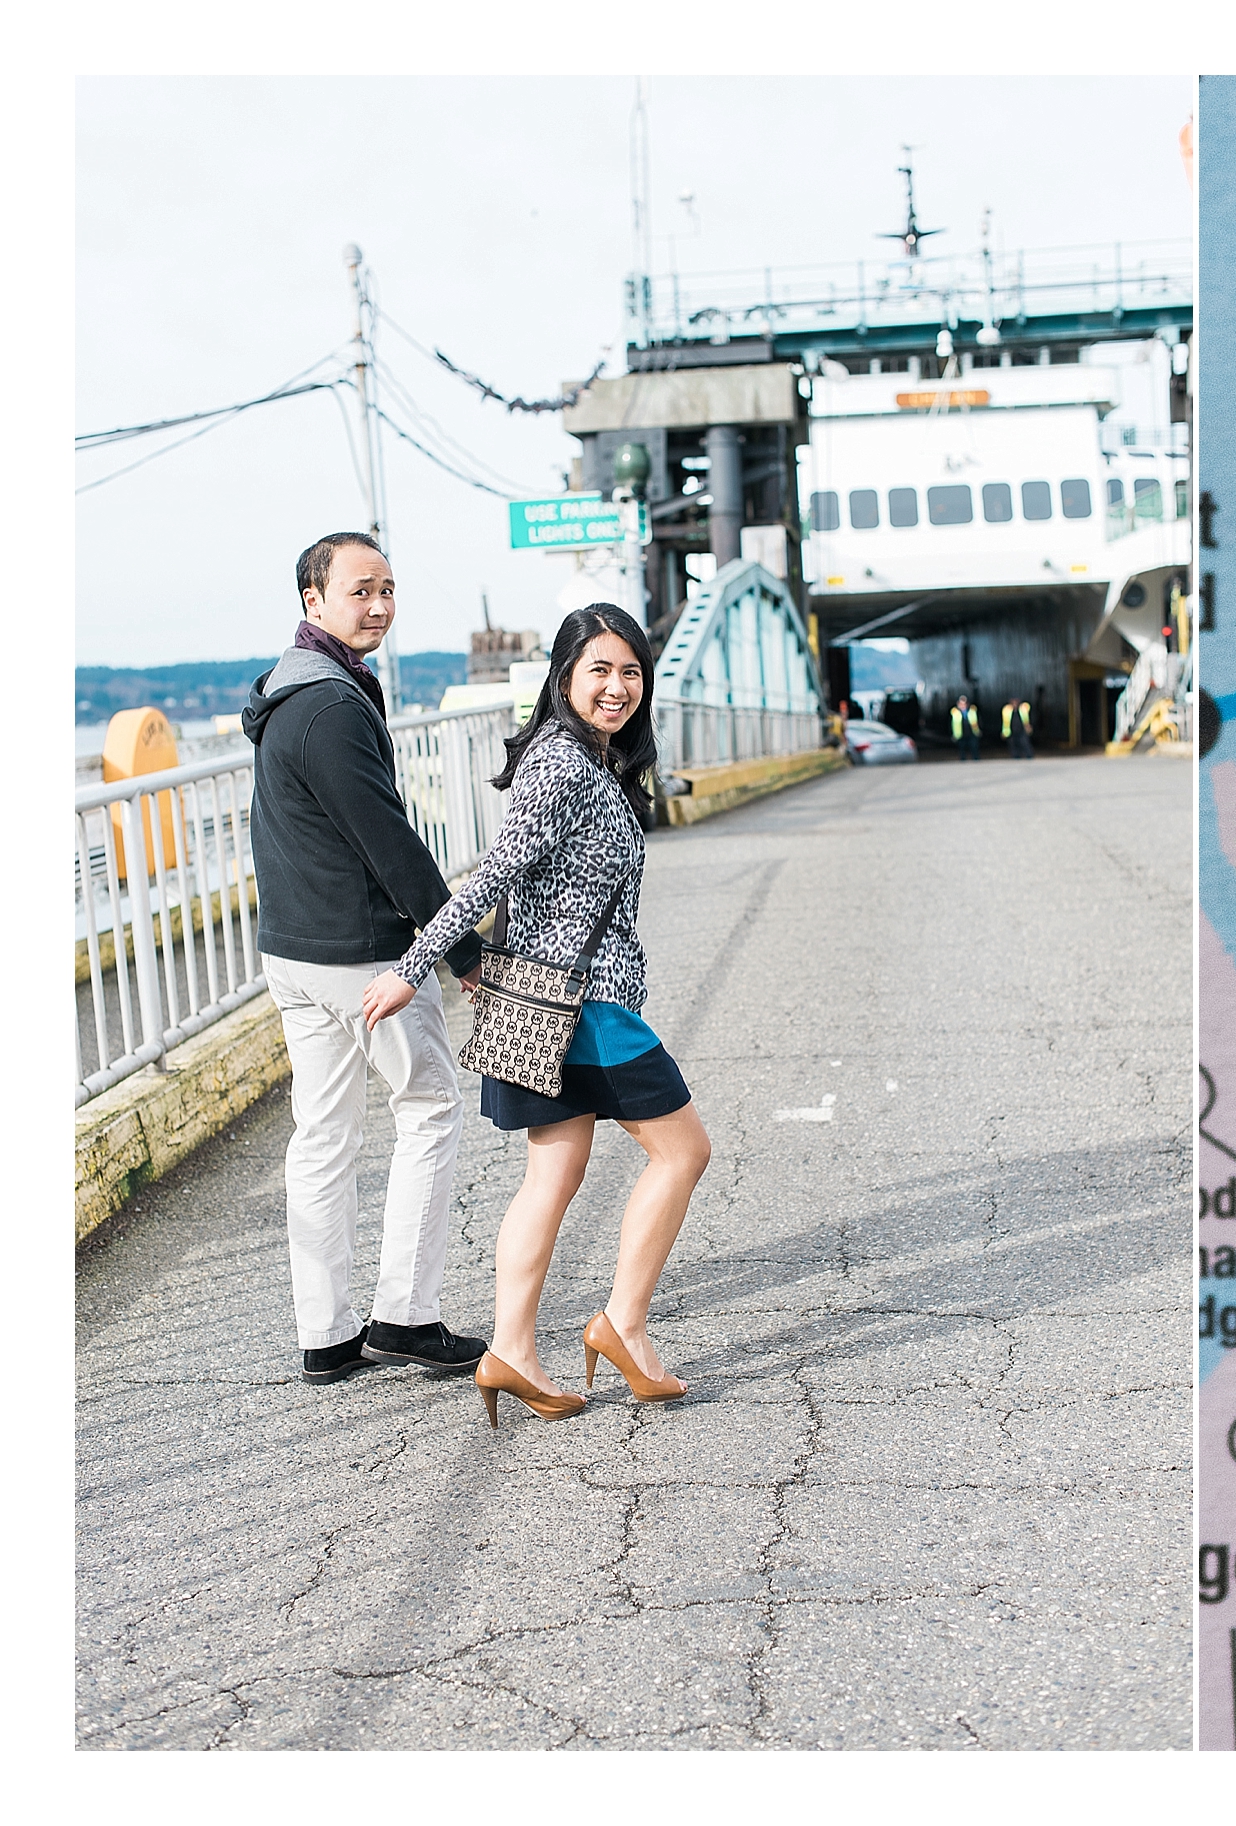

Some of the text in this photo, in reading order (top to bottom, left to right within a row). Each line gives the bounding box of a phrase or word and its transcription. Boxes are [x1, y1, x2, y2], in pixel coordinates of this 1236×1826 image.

[524, 501, 620, 522] USE PARKIN
[528, 523, 584, 543] LIGHTS
